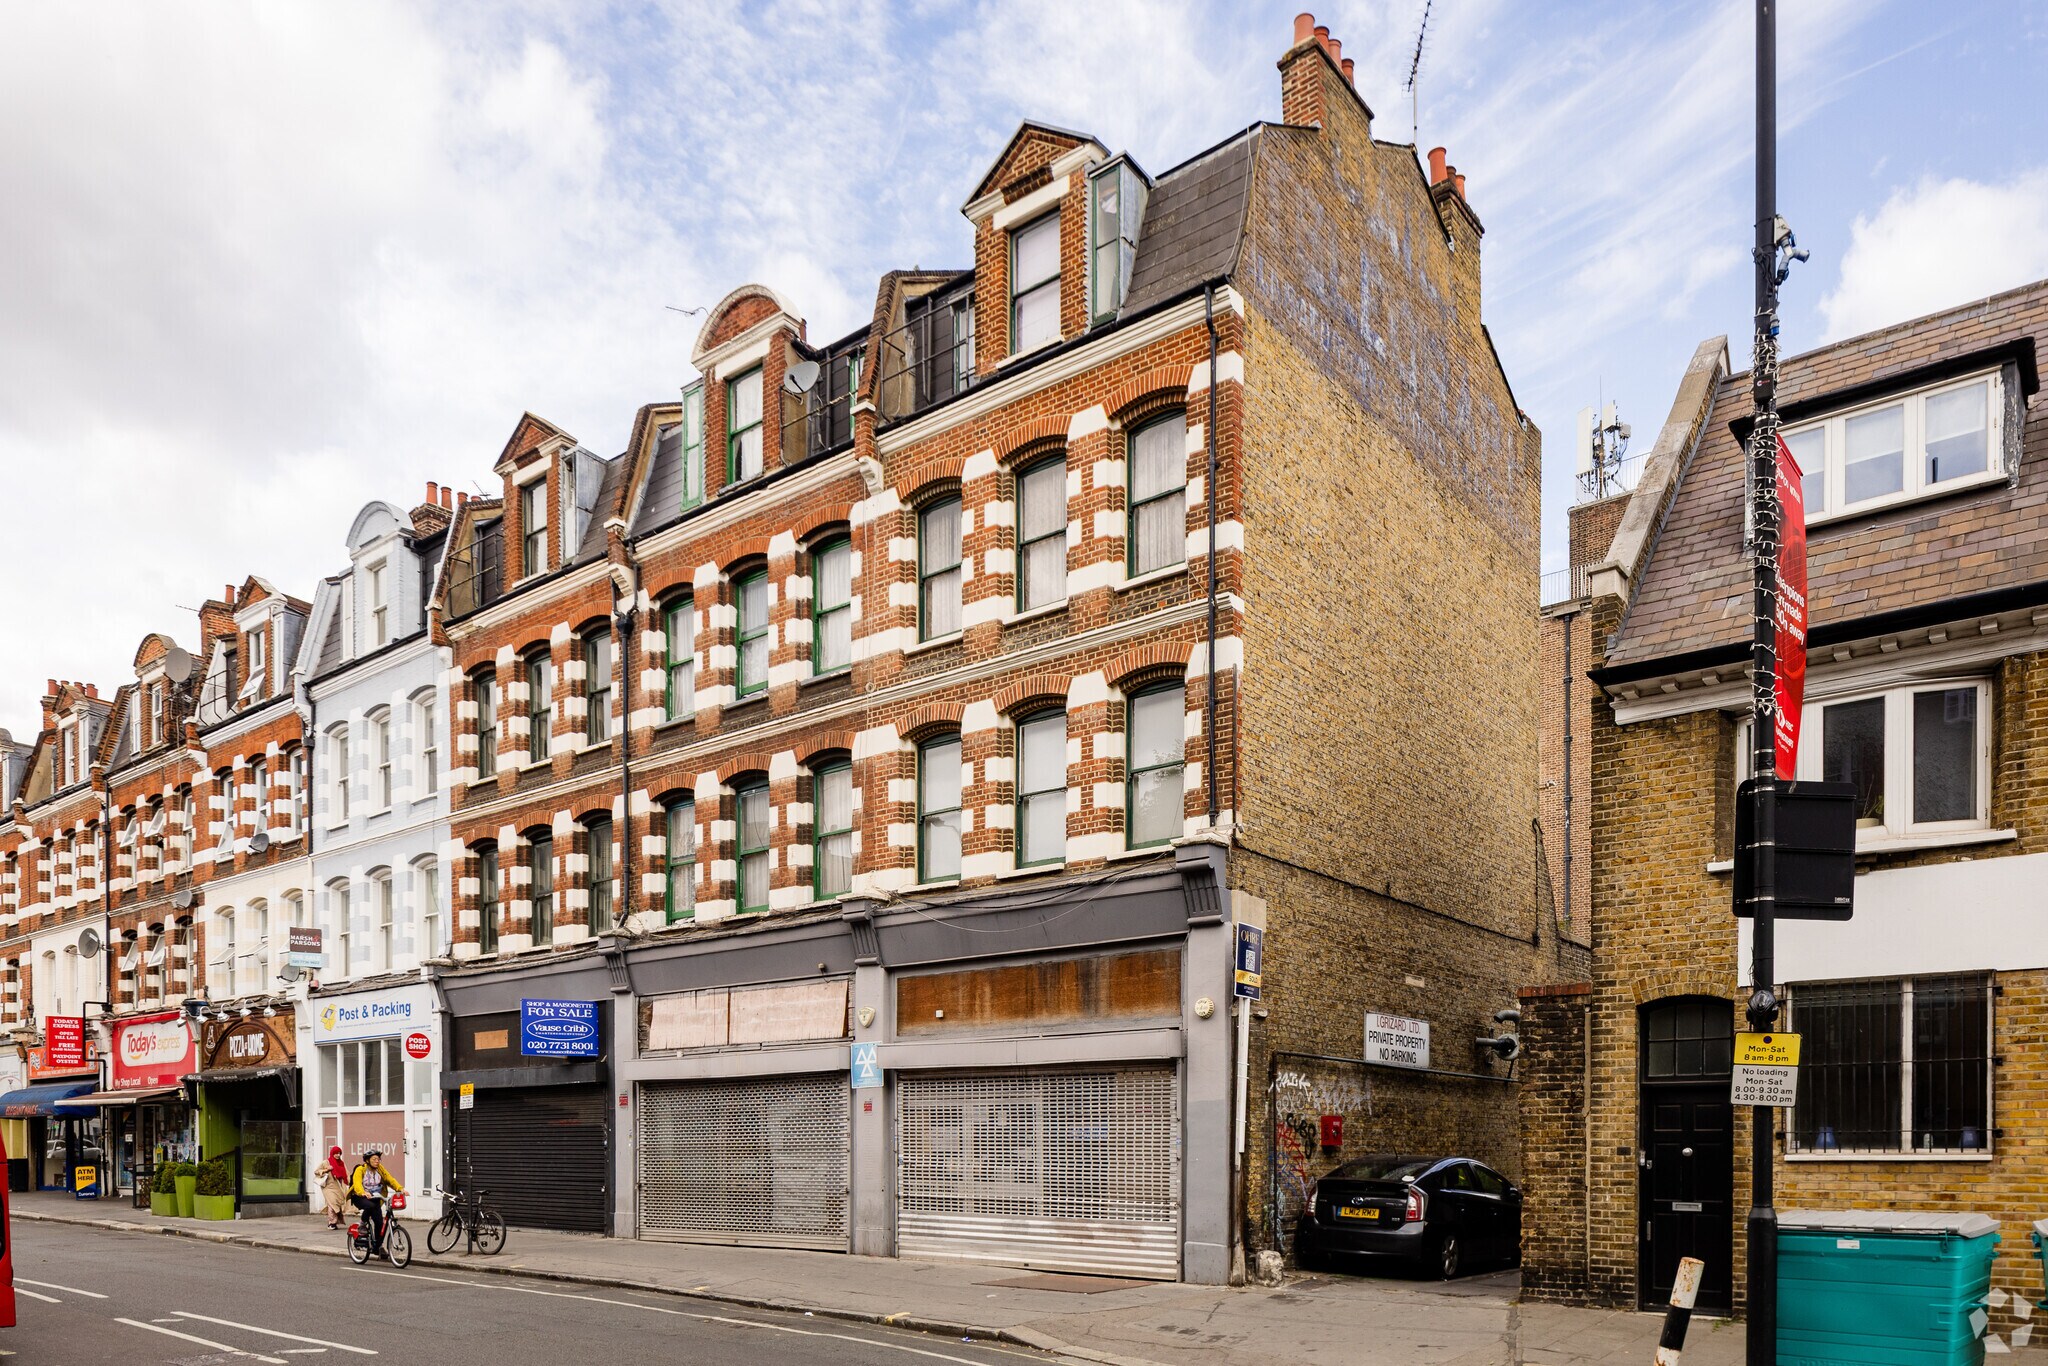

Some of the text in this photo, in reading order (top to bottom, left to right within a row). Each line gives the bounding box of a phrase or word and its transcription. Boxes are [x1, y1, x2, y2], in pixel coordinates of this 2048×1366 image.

[1789, 623, 1805, 645] away
[339, 1001, 411, 1021] Post & Packing
[528, 1007, 593, 1018] FOR SALE
[533, 1024, 588, 1033] Vause Cribb
[1409, 1021, 1421, 1034] LTD.
[127, 1031, 181, 1056] Today's express
[1368, 1030, 1427, 1050] PRIVATE PROPERTY
[230, 1035, 245, 1057] PIZZA
[527, 1041, 594, 1050] 020 7731 8001
[1748, 1045, 1786, 1053] Mon-Sat
[1379, 1047, 1417, 1064] NO PARKING
[1744, 1053, 1750, 1061] 8
[1756, 1068, 1789, 1077] loading
[121, 1078, 130, 1087] Shop
[131, 1077, 141, 1086] Local
[148, 1076, 158, 1086] Open
[1745, 1078, 1783, 1086] Mon-Sat
[1735, 1086, 1779, 1094] 8.00-9.30
[1734, 1094, 1778, 1102] 4.30-8.00
[1344, 1207, 1377, 1217] LM12 RMX
